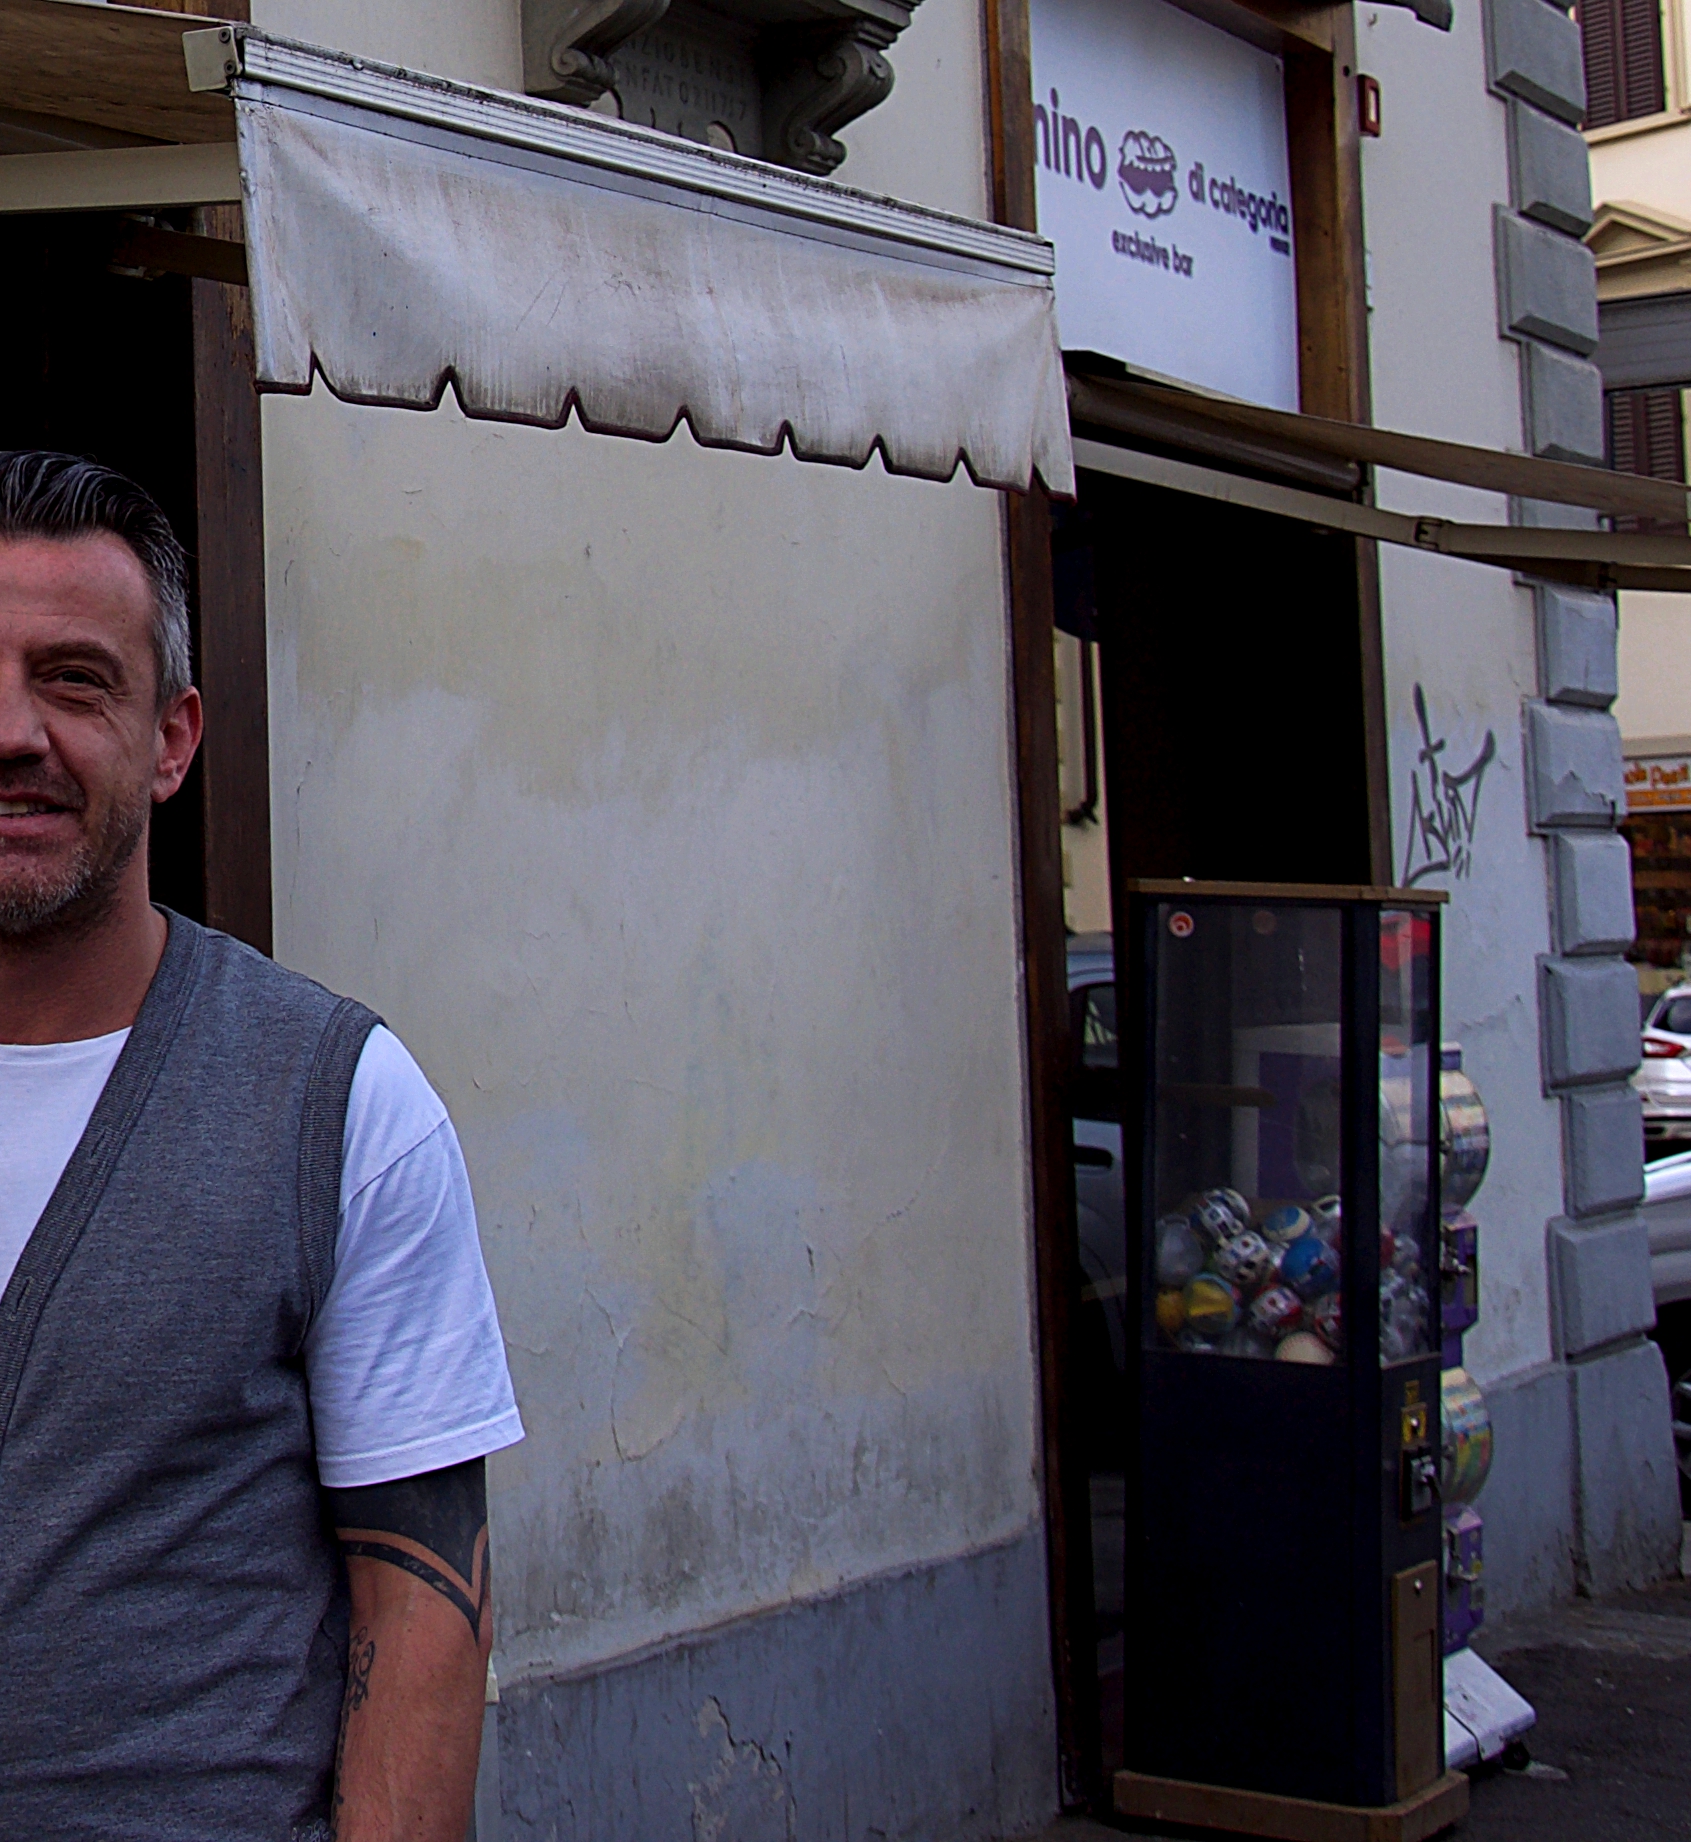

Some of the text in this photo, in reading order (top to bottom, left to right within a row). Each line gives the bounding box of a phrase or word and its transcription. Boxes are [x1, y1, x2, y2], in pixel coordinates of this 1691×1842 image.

[1033, 86, 1288, 233] nino di categoria
[1112, 229, 1193, 277] exclusive bar
